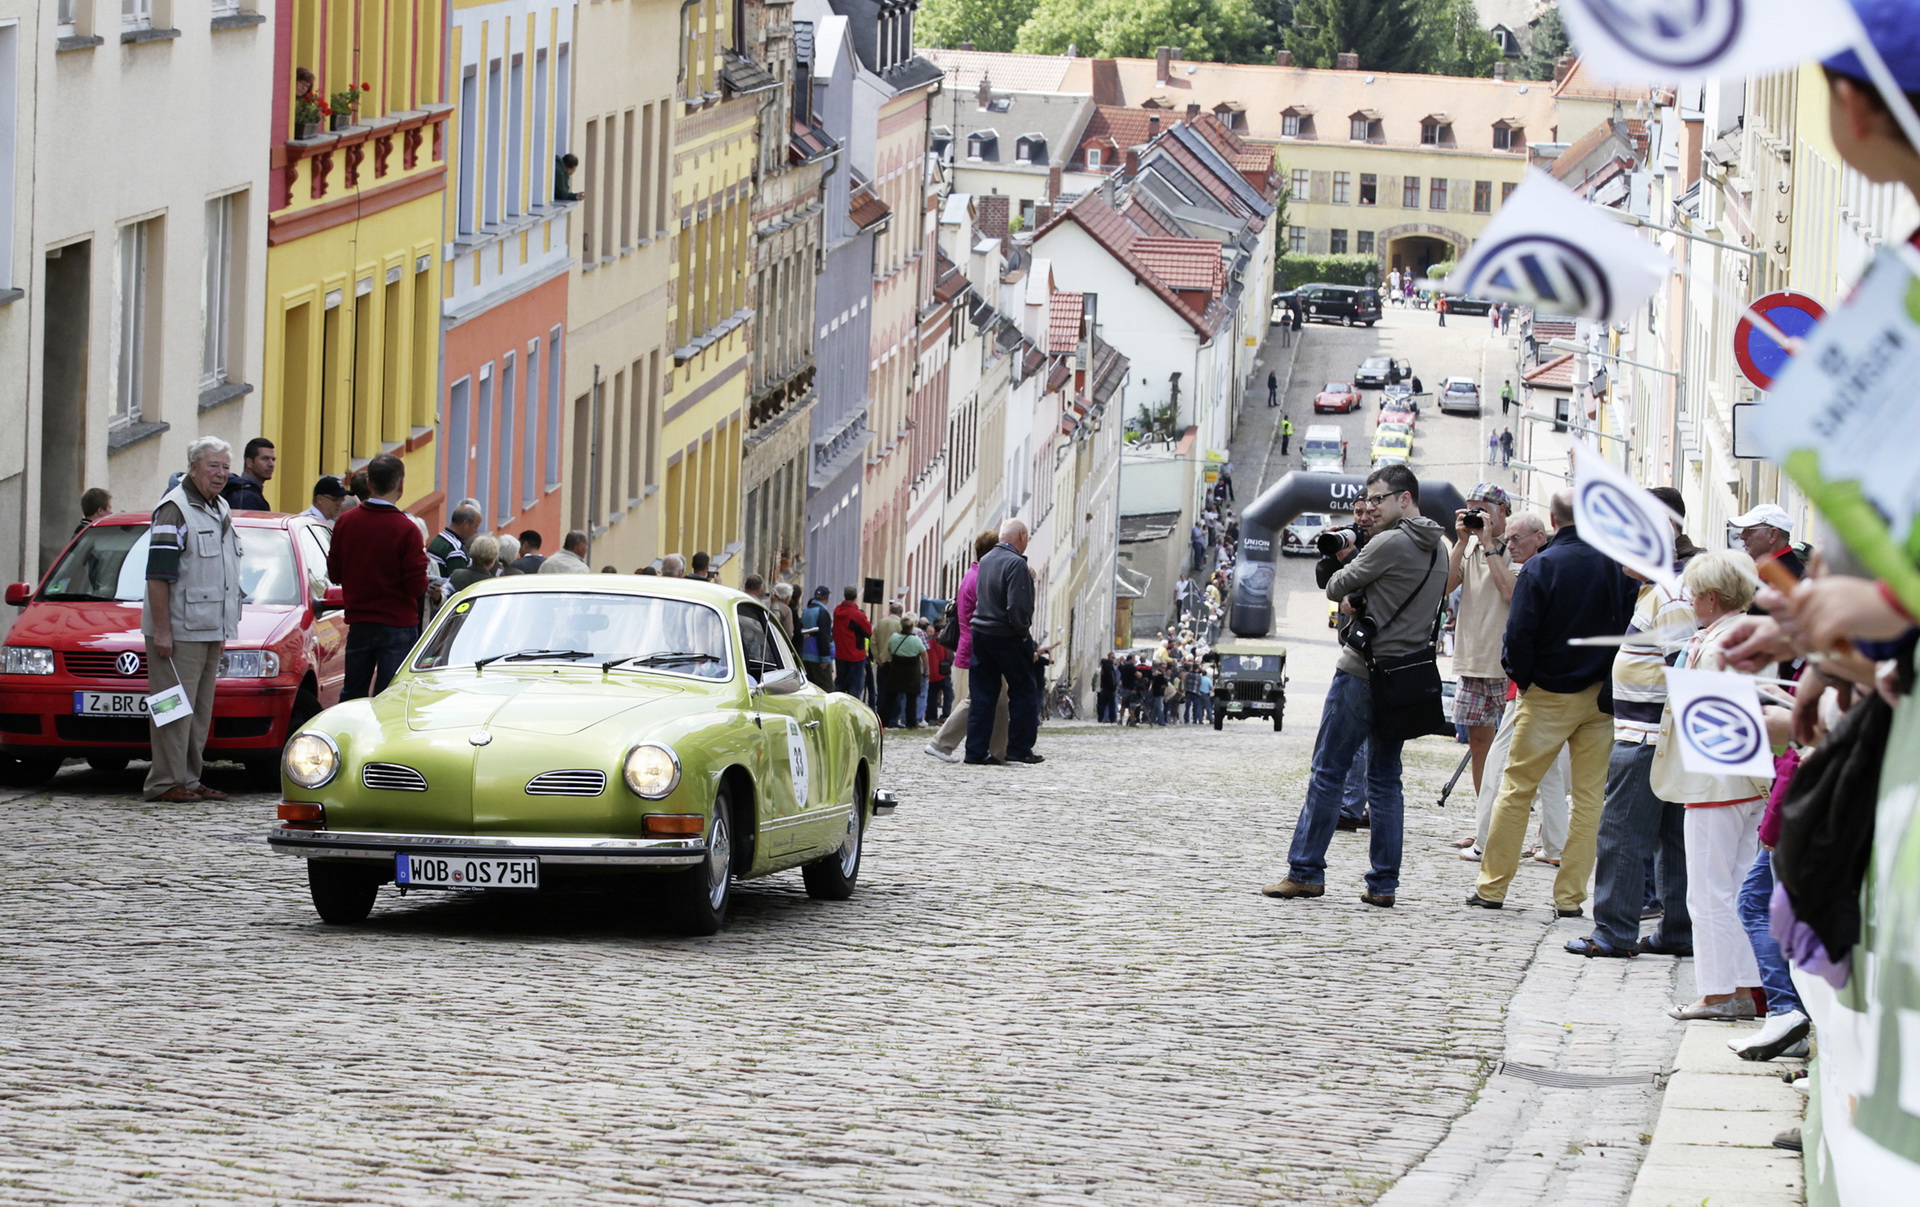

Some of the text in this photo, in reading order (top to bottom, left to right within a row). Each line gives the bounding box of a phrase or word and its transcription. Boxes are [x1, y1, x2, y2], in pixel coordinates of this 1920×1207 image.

[1331, 483, 1363, 498] UN
[1330, 501, 1354, 510] GLAS
[1244, 538, 1270, 547] UNION
[90, 695, 100, 711] Z
[112, 696, 133, 712] BR
[794, 746, 804, 777] 33
[410, 858, 449, 881] WOB
